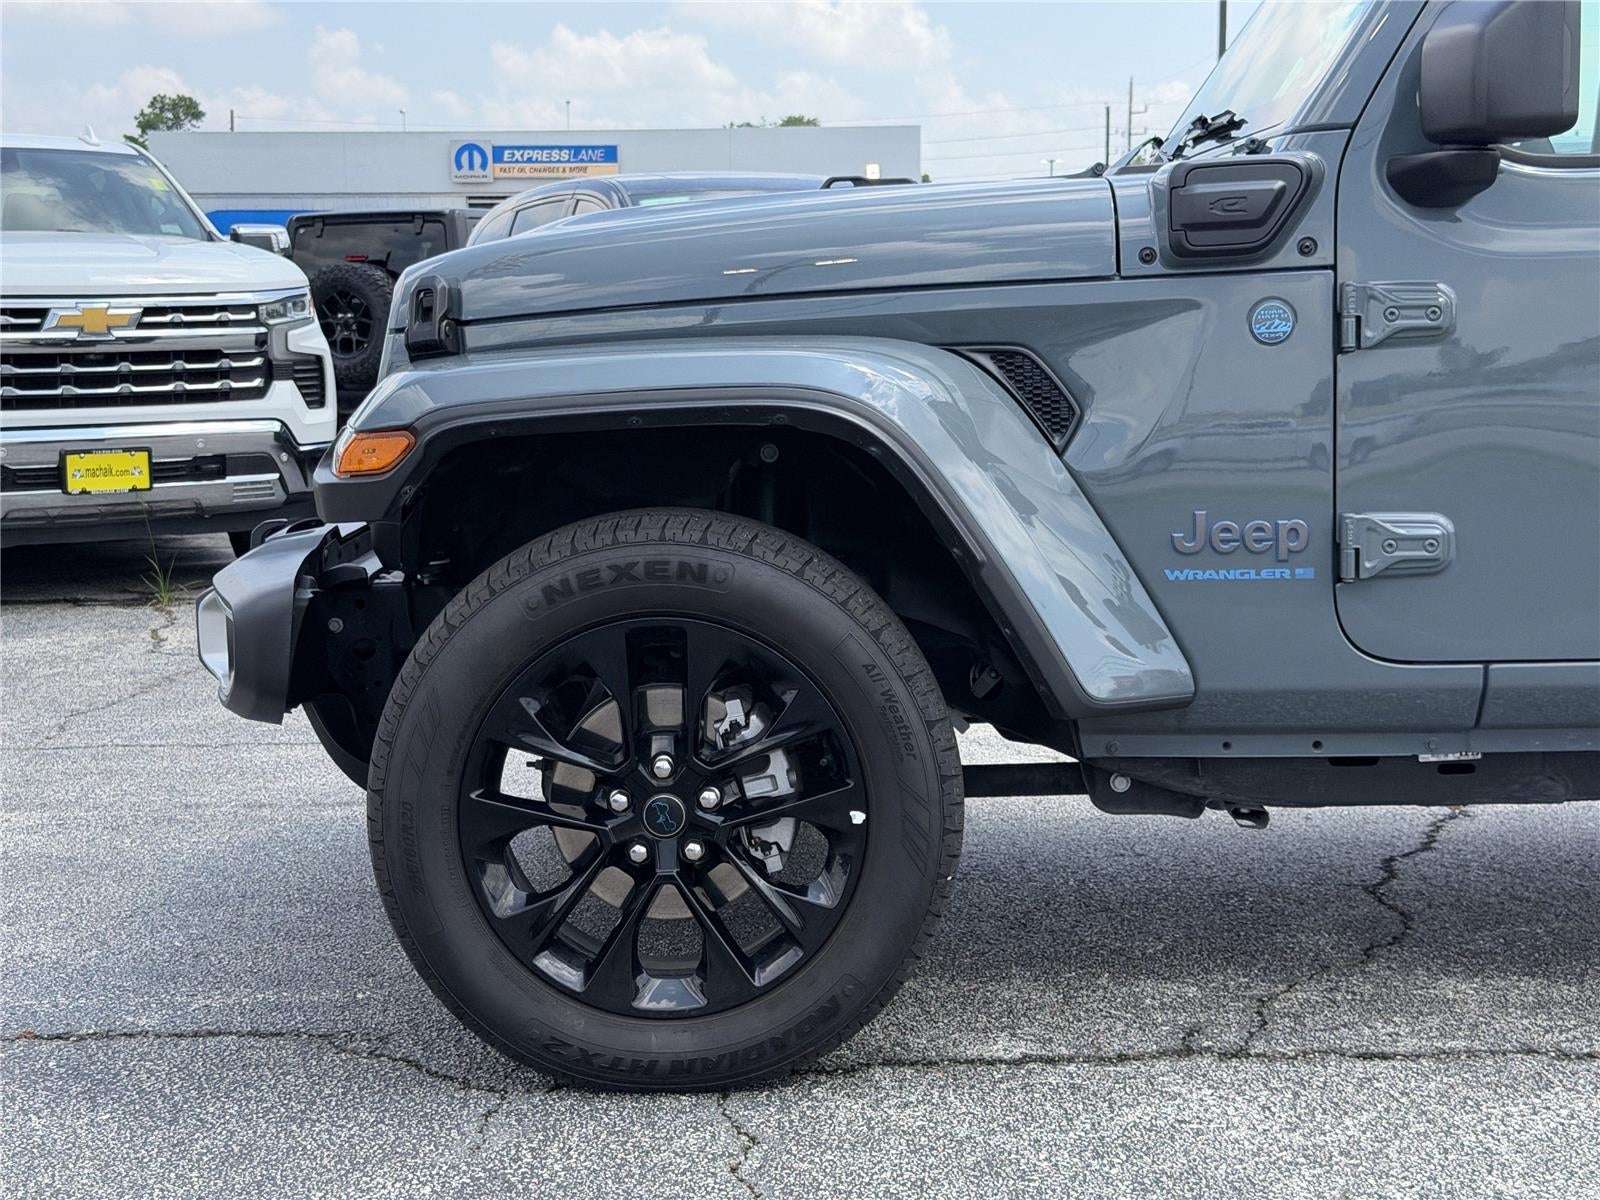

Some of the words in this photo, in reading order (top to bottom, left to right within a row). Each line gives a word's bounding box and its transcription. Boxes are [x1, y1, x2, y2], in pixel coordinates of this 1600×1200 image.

[499, 166, 515, 174] FAST
[529, 166, 560, 174] CHANGES
[568, 165, 589, 174] MORE
[85, 464, 130, 478] machaik.com
[1170, 510, 1310, 562] Jeep
[1162, 568, 1292, 581] WRANGLER
[540, 560, 708, 604] NEXEN
